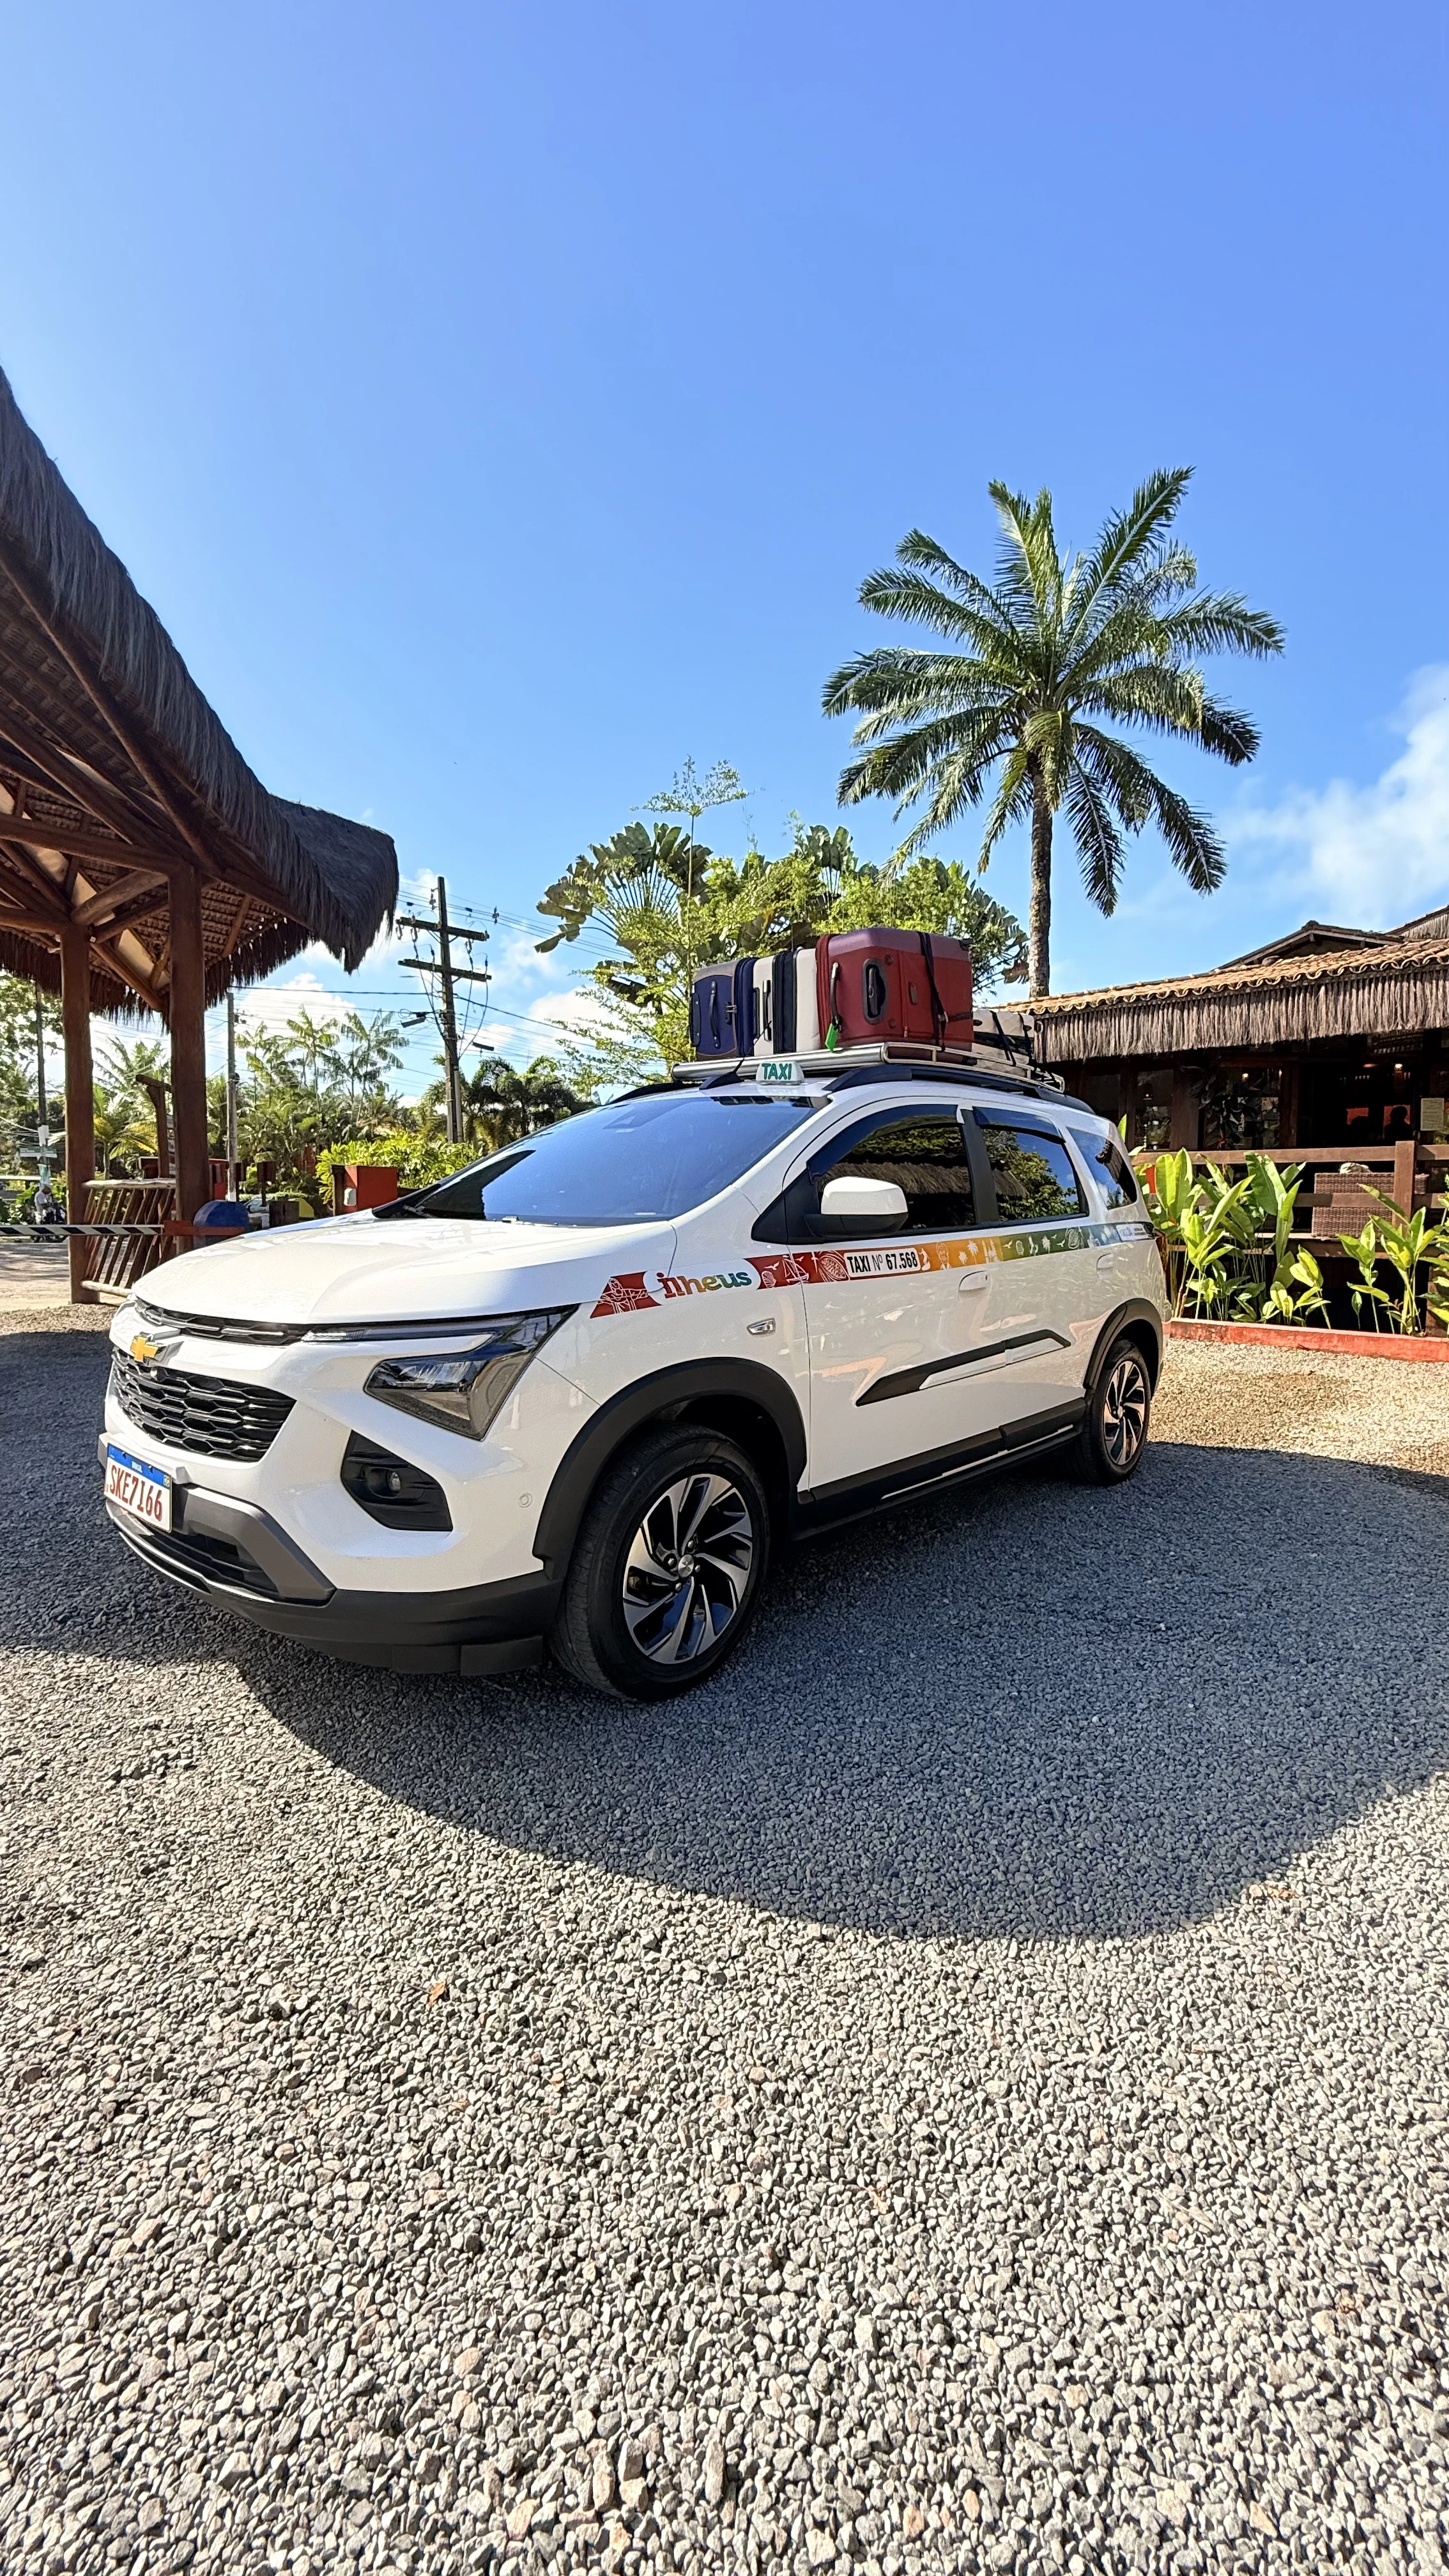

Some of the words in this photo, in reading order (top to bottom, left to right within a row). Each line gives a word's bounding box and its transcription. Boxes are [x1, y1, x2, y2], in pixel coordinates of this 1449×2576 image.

[762, 1062, 792, 1080] TAXI
[847, 1255, 871, 1273] TAXI
[885, 1251, 918, 1270] 67.568
